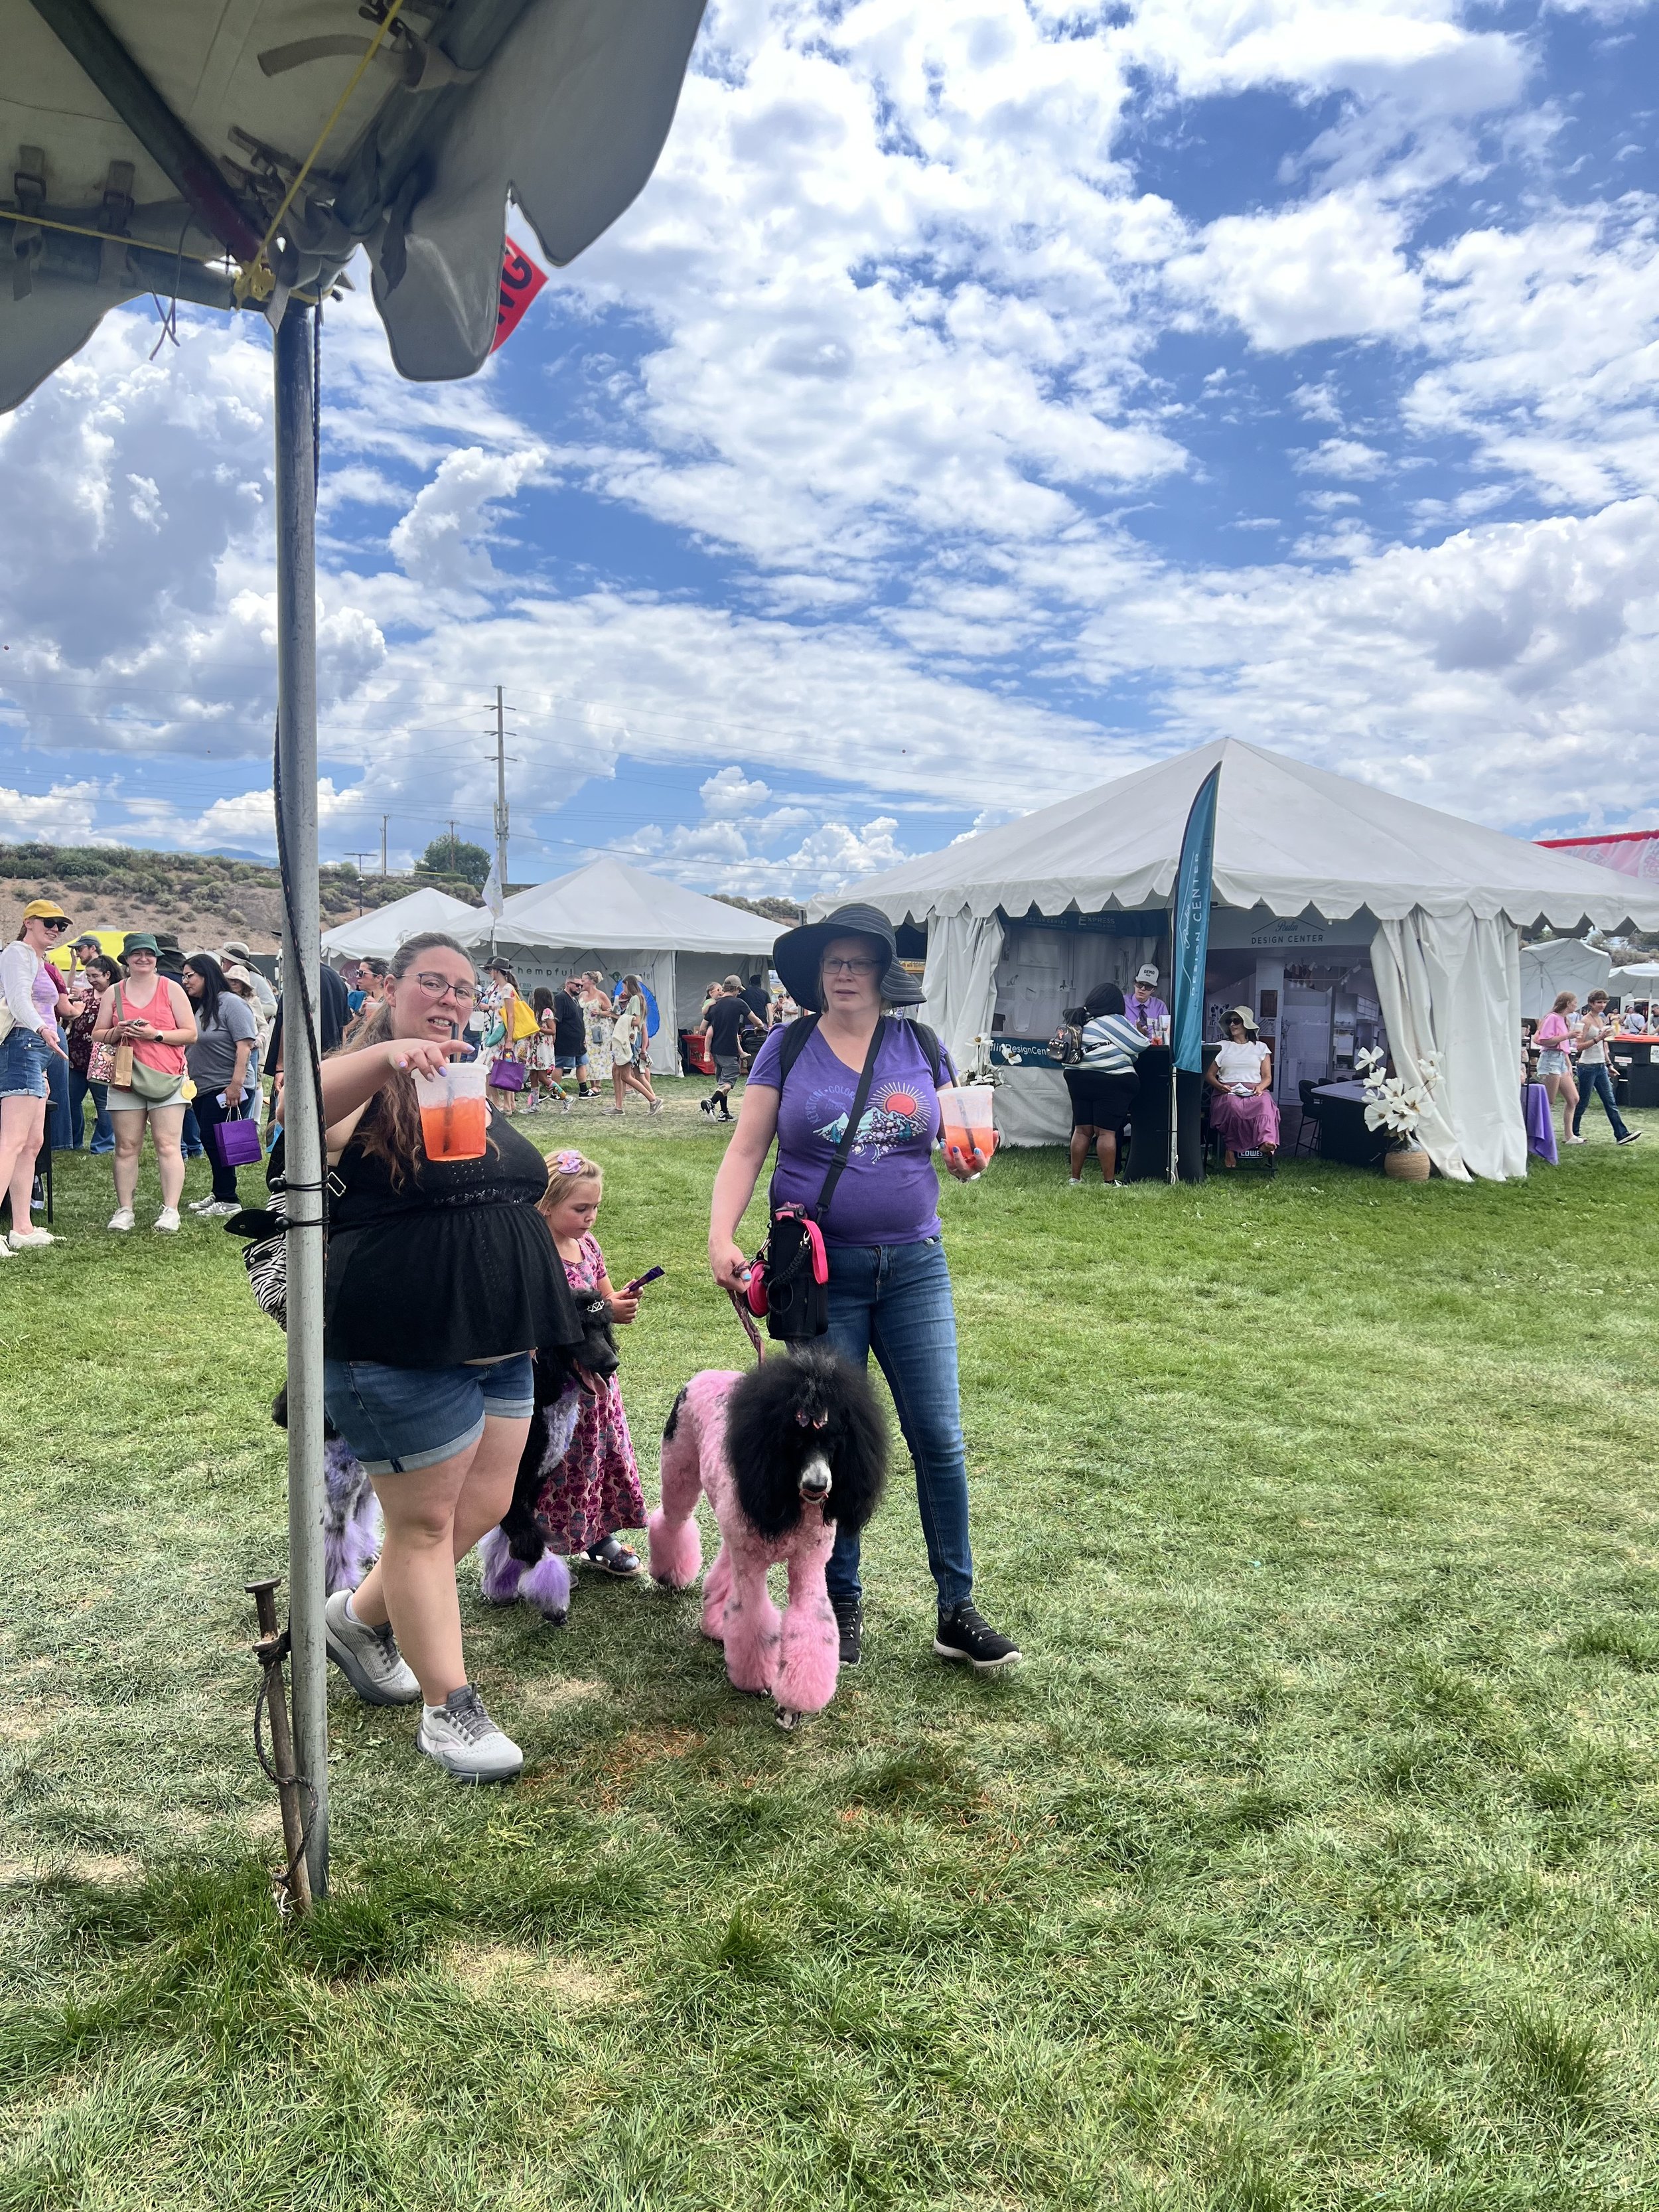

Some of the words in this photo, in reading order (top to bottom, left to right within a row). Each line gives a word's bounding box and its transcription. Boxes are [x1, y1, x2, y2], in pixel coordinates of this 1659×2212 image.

[1192, 853, 1203, 922] CENTER
[1275, 920, 1299, 932] Poulin
[1252, 936, 1283, 944] DESIGN
[1191, 932, 1200, 997] DESIGN
[828, 1084, 855, 1102] COLOR
